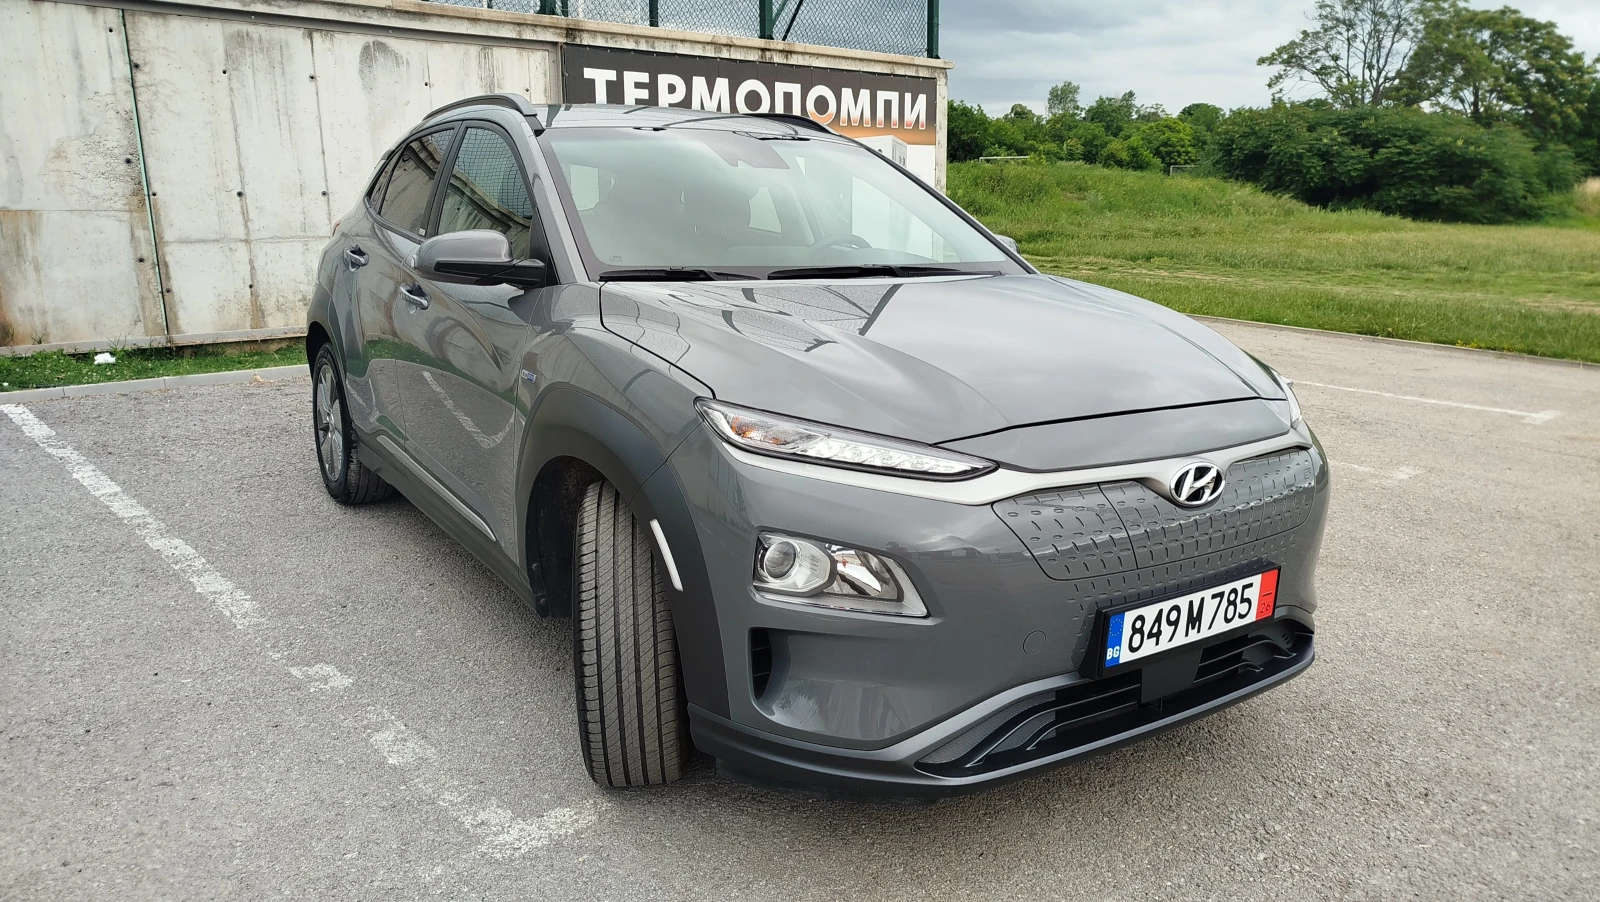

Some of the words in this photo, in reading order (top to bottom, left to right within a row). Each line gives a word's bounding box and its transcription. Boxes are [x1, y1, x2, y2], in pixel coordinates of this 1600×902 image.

[583, 68, 927, 130] ТЕРМОПОМПИ
[1259, 601, 1271, 614] 26
[1106, 645, 1120, 661] BG
